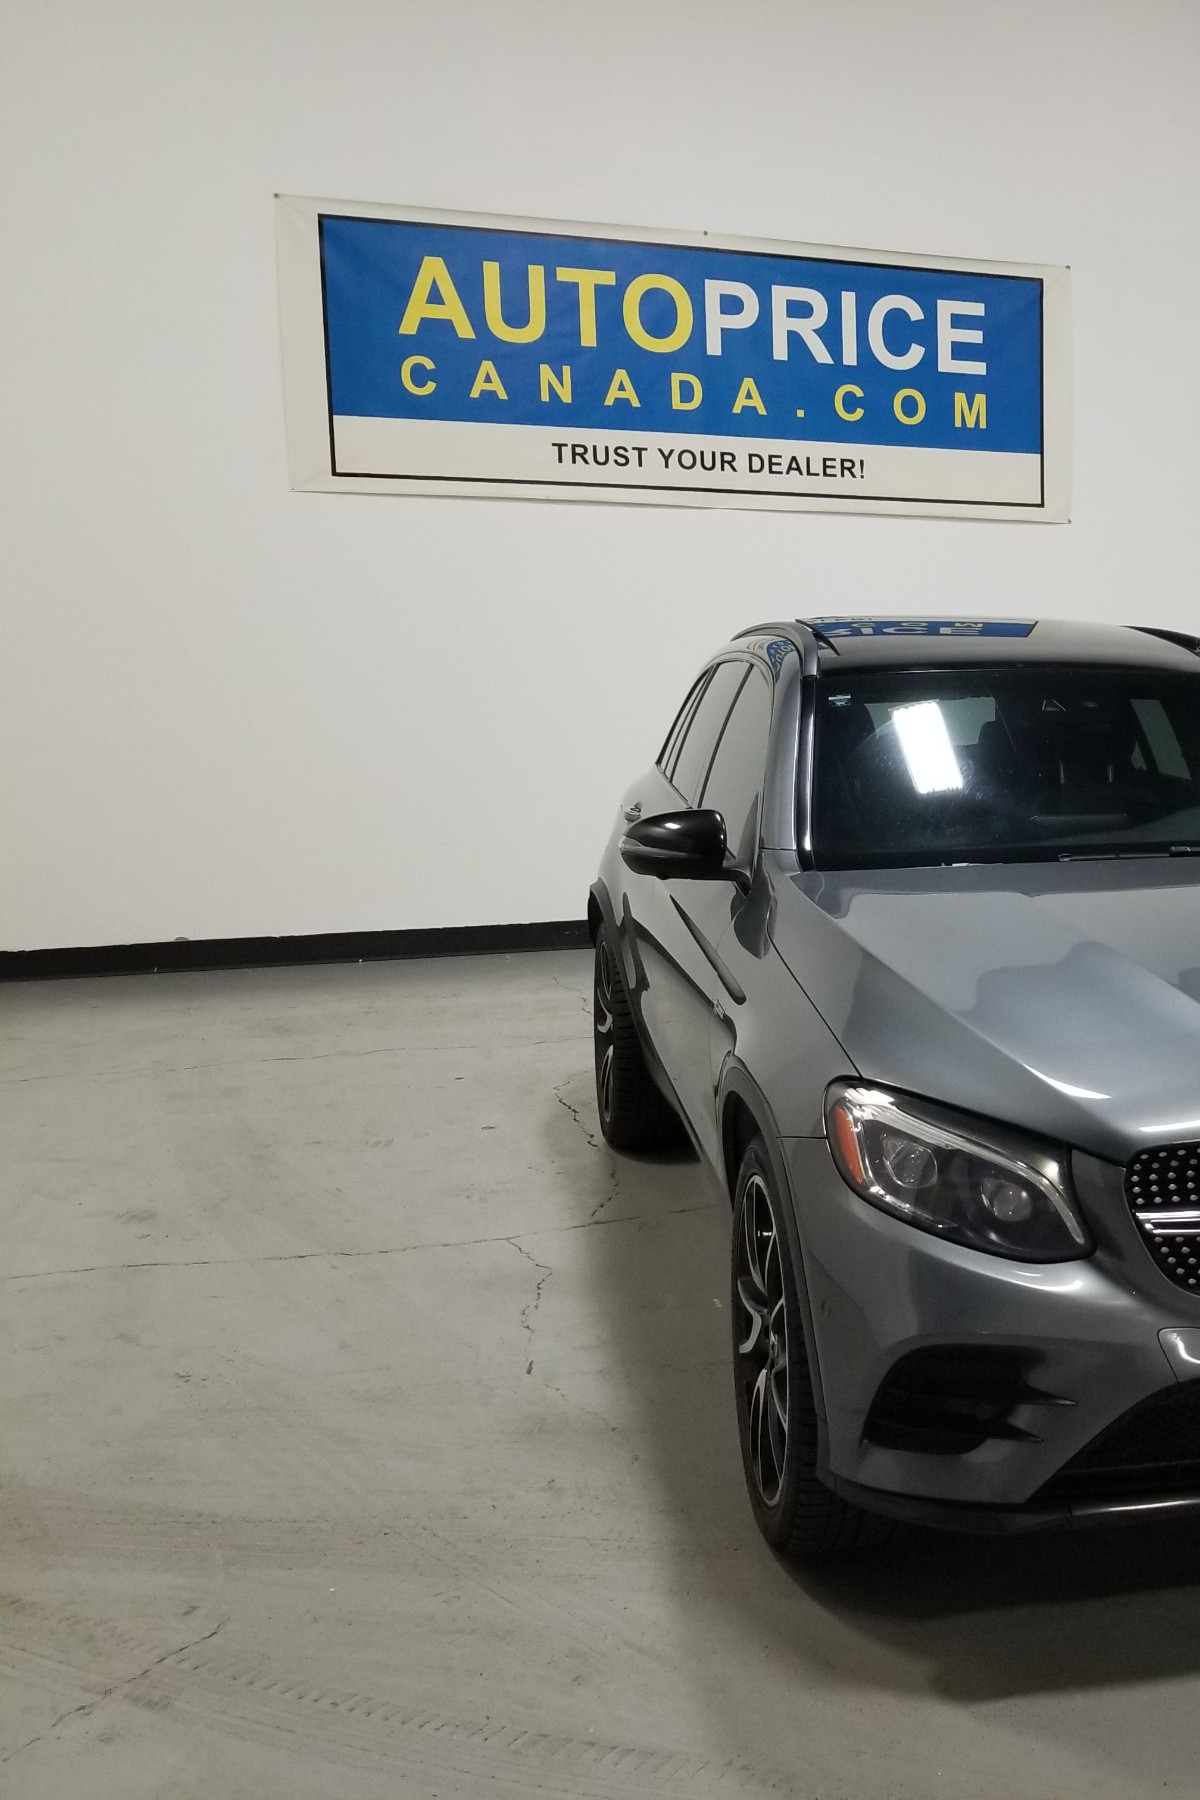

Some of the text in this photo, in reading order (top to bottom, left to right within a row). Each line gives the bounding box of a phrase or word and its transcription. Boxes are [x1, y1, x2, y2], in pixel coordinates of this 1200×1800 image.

[398, 255, 987, 376] AUTOPRICE
[551, 442, 866, 479] TRUST YOUR DEALER!
